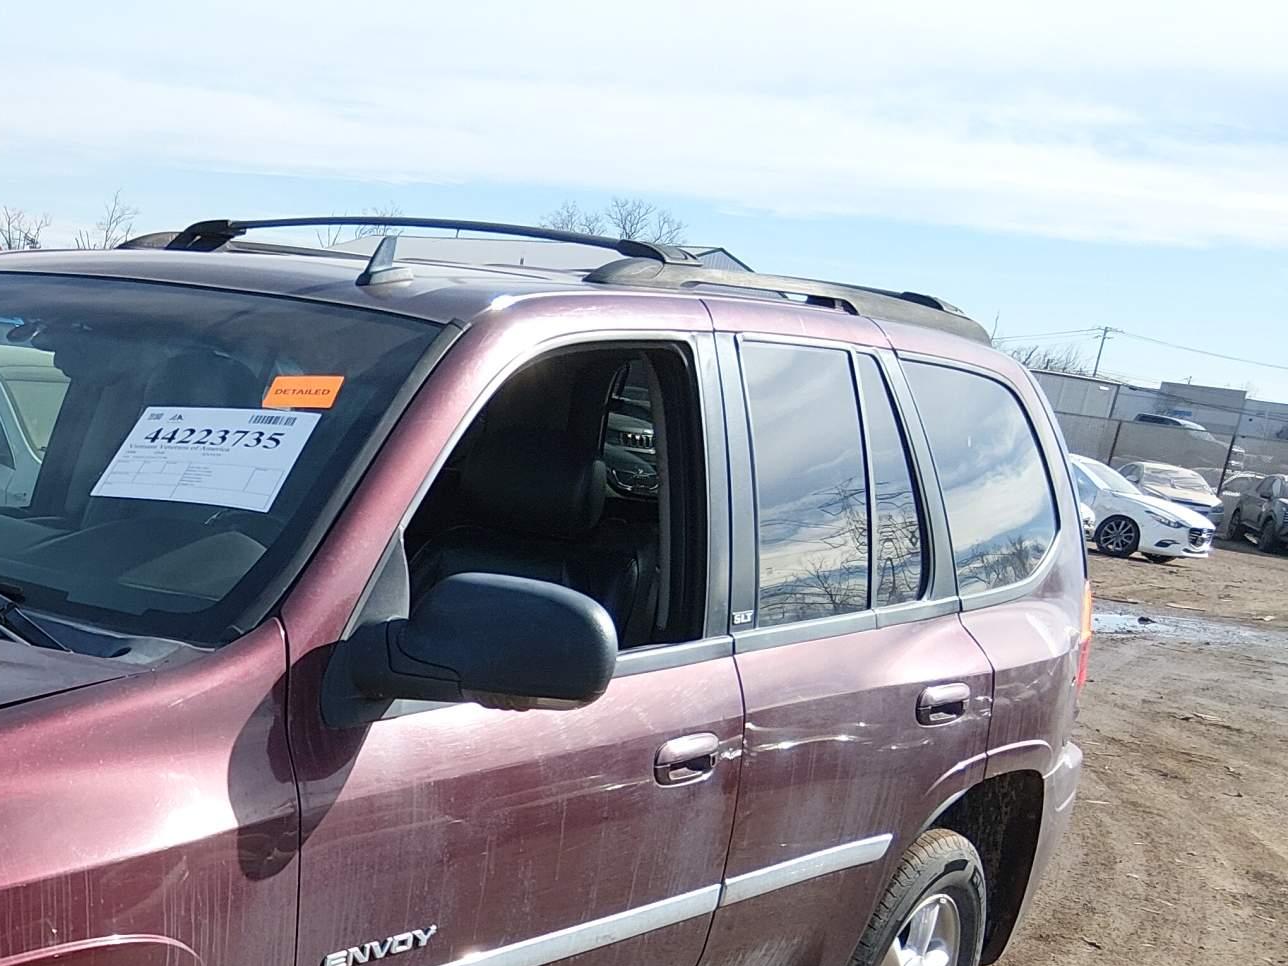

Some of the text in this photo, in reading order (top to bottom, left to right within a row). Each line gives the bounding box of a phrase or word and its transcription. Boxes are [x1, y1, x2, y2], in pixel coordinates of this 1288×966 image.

[274, 388, 331, 396] DETAILED
[144, 427, 285, 449] 44223735
[732, 610, 754, 625] SLT
